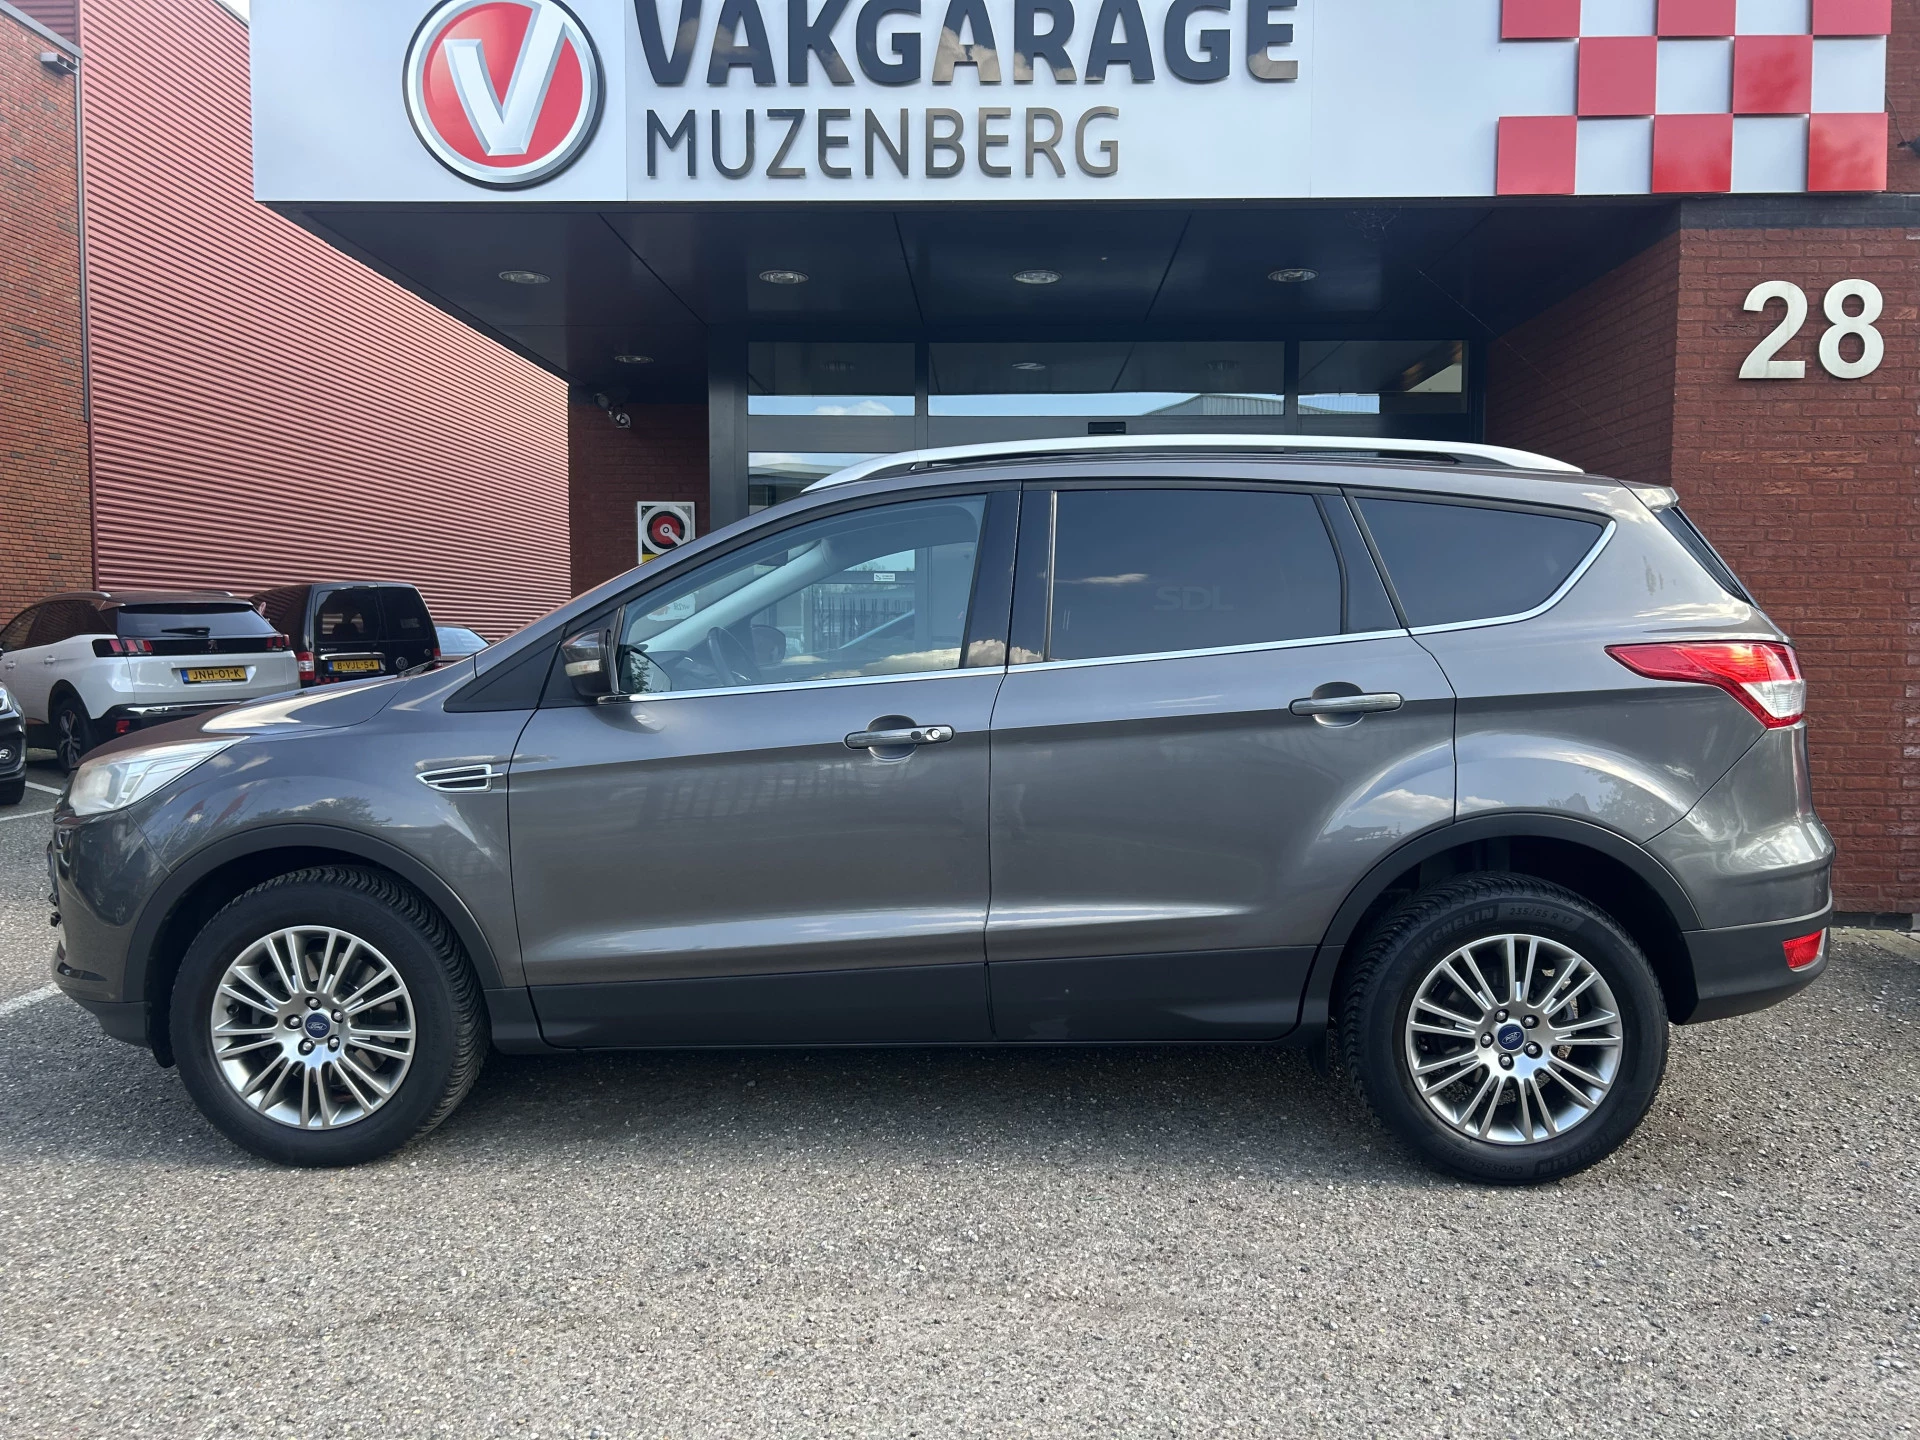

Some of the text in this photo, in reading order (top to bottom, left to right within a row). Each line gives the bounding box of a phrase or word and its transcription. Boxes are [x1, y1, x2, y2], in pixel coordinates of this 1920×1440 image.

[633, 0, 1299, 84] VAKGARAGE
[646, 106, 1120, 179] MUZENBERG
[1739, 278, 1885, 379] 28
[1152, 584, 1236, 611] SDL
[193, 668, 242, 680] JNH-01-K
[337, 661, 375, 670] B-VJL-54
[1411, 906, 1494, 960] MICHELIN
[1509, 907, 1548, 919] 235/55
[1561, 914, 1574, 925] 17
